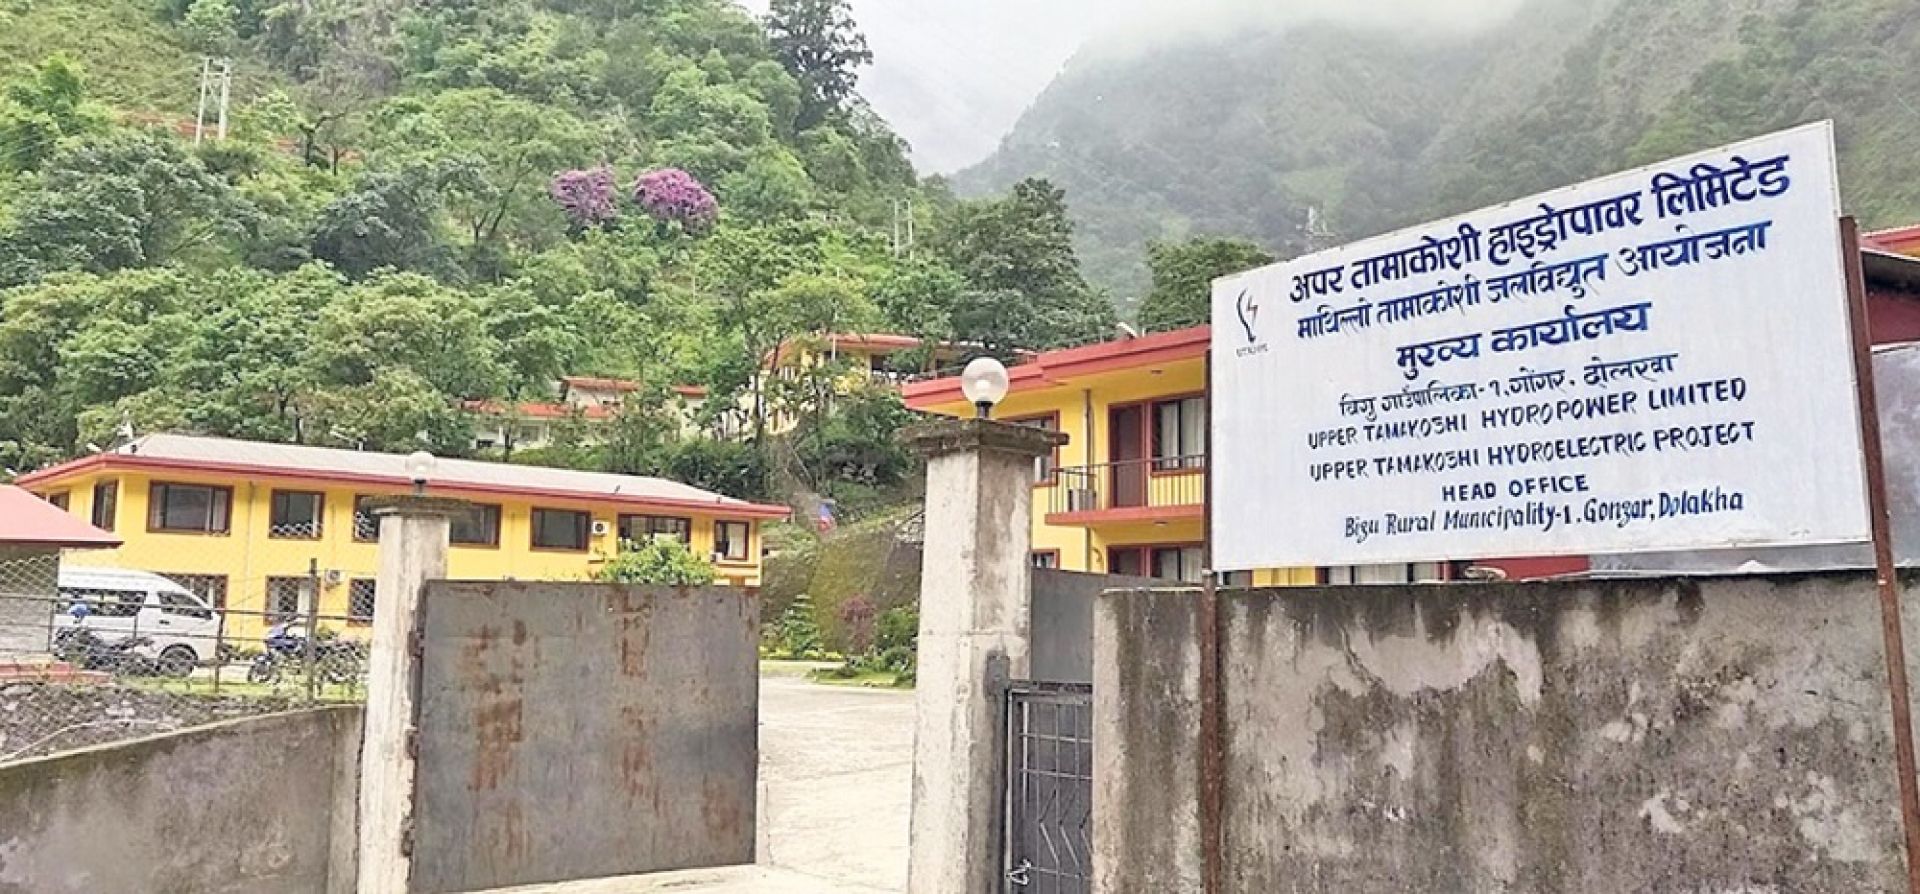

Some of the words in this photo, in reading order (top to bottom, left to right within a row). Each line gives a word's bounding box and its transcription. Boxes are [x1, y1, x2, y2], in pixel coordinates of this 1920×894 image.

[1289, 266, 1345, 302] अपर
[1350, 223, 1482, 289] तामाकोशी
[1651, 155, 1791, 219] लिमिटेड
[1376, 274, 1481, 325] तामाकोशी
[1616, 220, 1773, 277] आयोजना
[1397, 333, 1482, 380] मुख्य
[1492, 302, 1653, 353] कार्यालय
[1308, 427, 1358, 450] UPPER
[1363, 413, 1468, 443] TAMAKOSHI
[1481, 391, 1637, 429] HYDROPOWER
[1649, 377, 1747, 410] LIMITED
[1310, 458, 1369, 482] UPPER
[1373, 448, 1480, 477] TAMAKOSHI
[1487, 431, 1647, 466] HYDROELECTRIC
[1653, 421, 1756, 451] PROJECT
[1442, 482, 1497, 502] HEAD
[1508, 474, 1589, 498] OFFICE
[1344, 516, 1380, 544] Bigu
[1384, 510, 1437, 536] Rural
[1658, 485, 1745, 519] Dolakha
